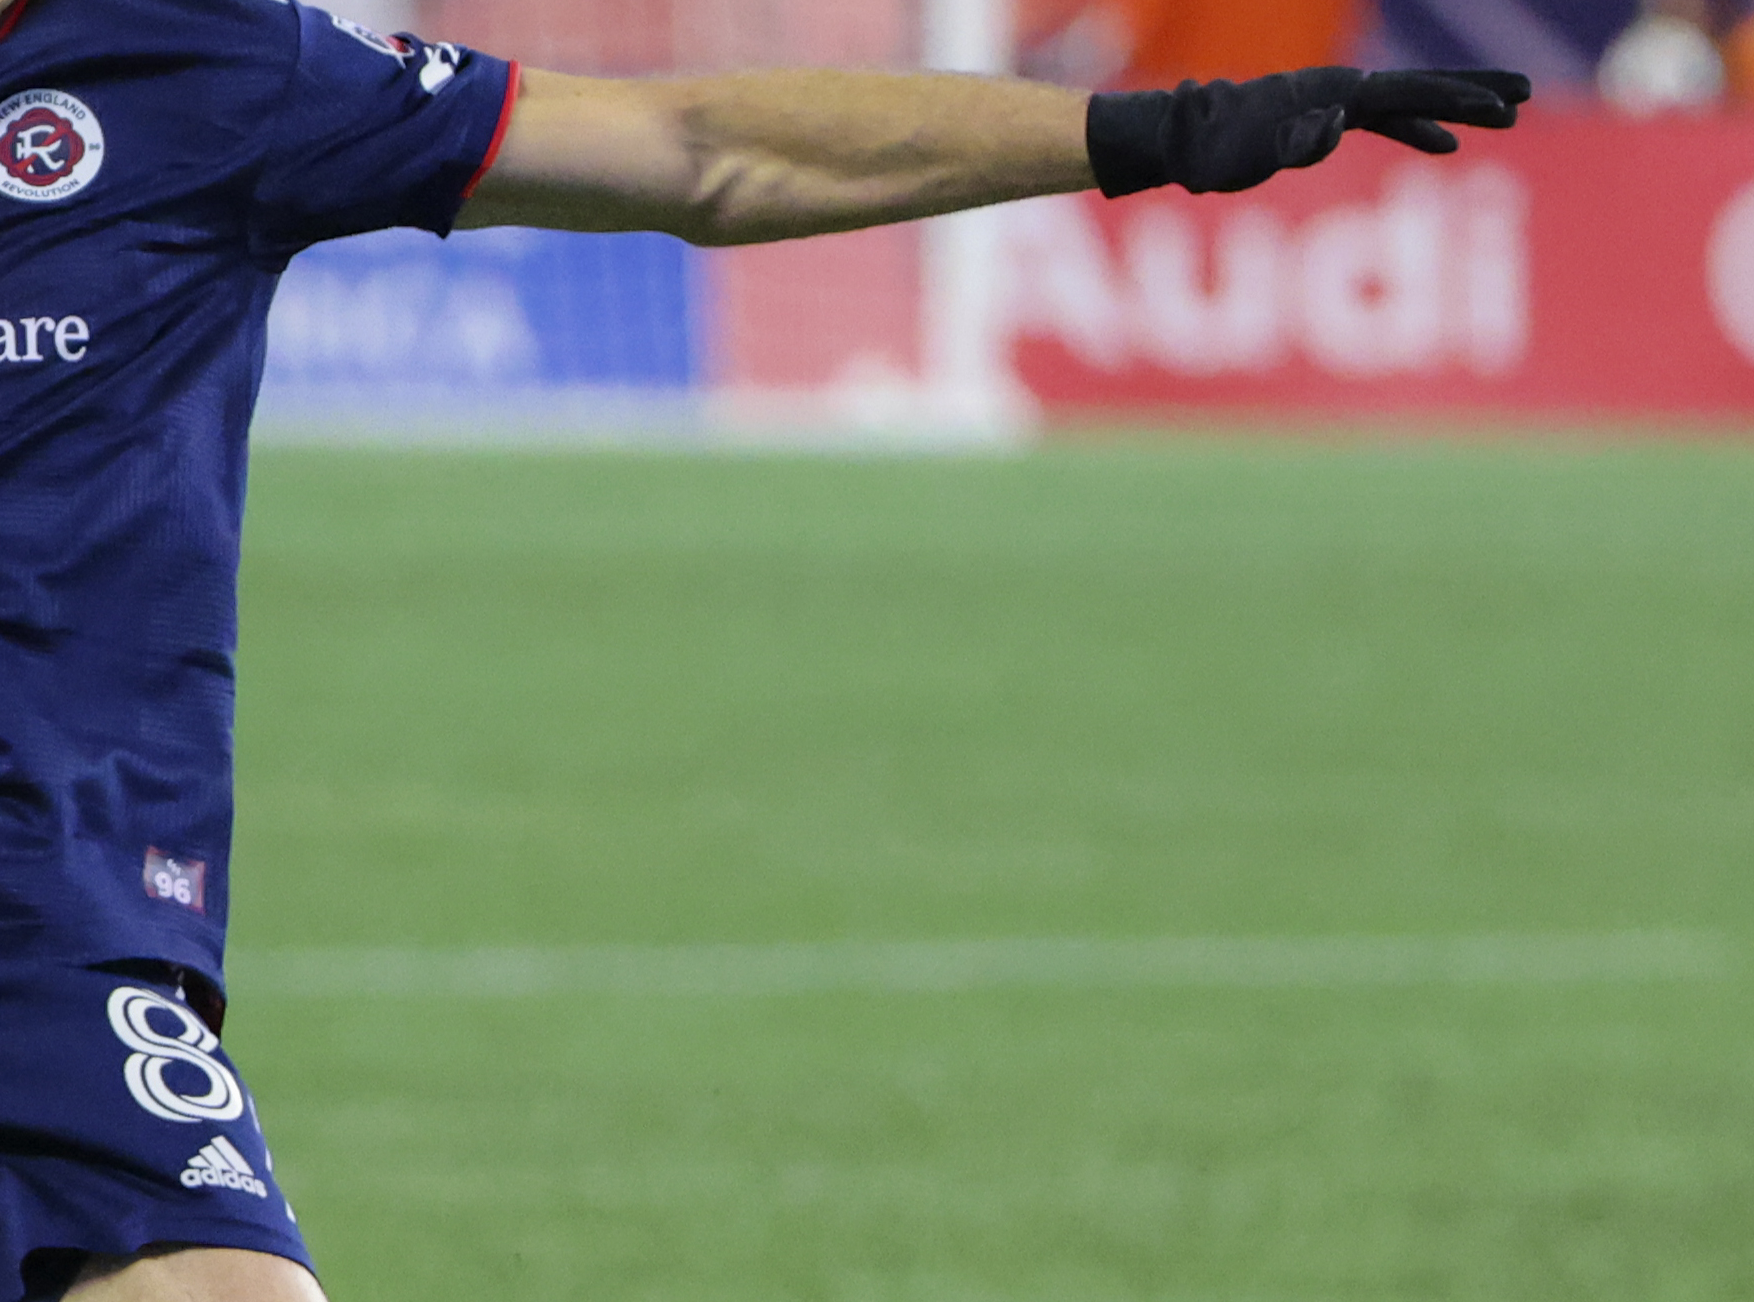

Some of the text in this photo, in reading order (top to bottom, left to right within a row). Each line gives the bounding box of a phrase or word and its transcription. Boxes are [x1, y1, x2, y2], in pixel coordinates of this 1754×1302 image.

[24, 93, 88, 121] ENGLAND
[1, 178, 81, 198] REVOLUTION
[154, 871, 192, 905] 96
[107, 985, 245, 1122] 8
[180, 1166, 268, 1199] adidas
